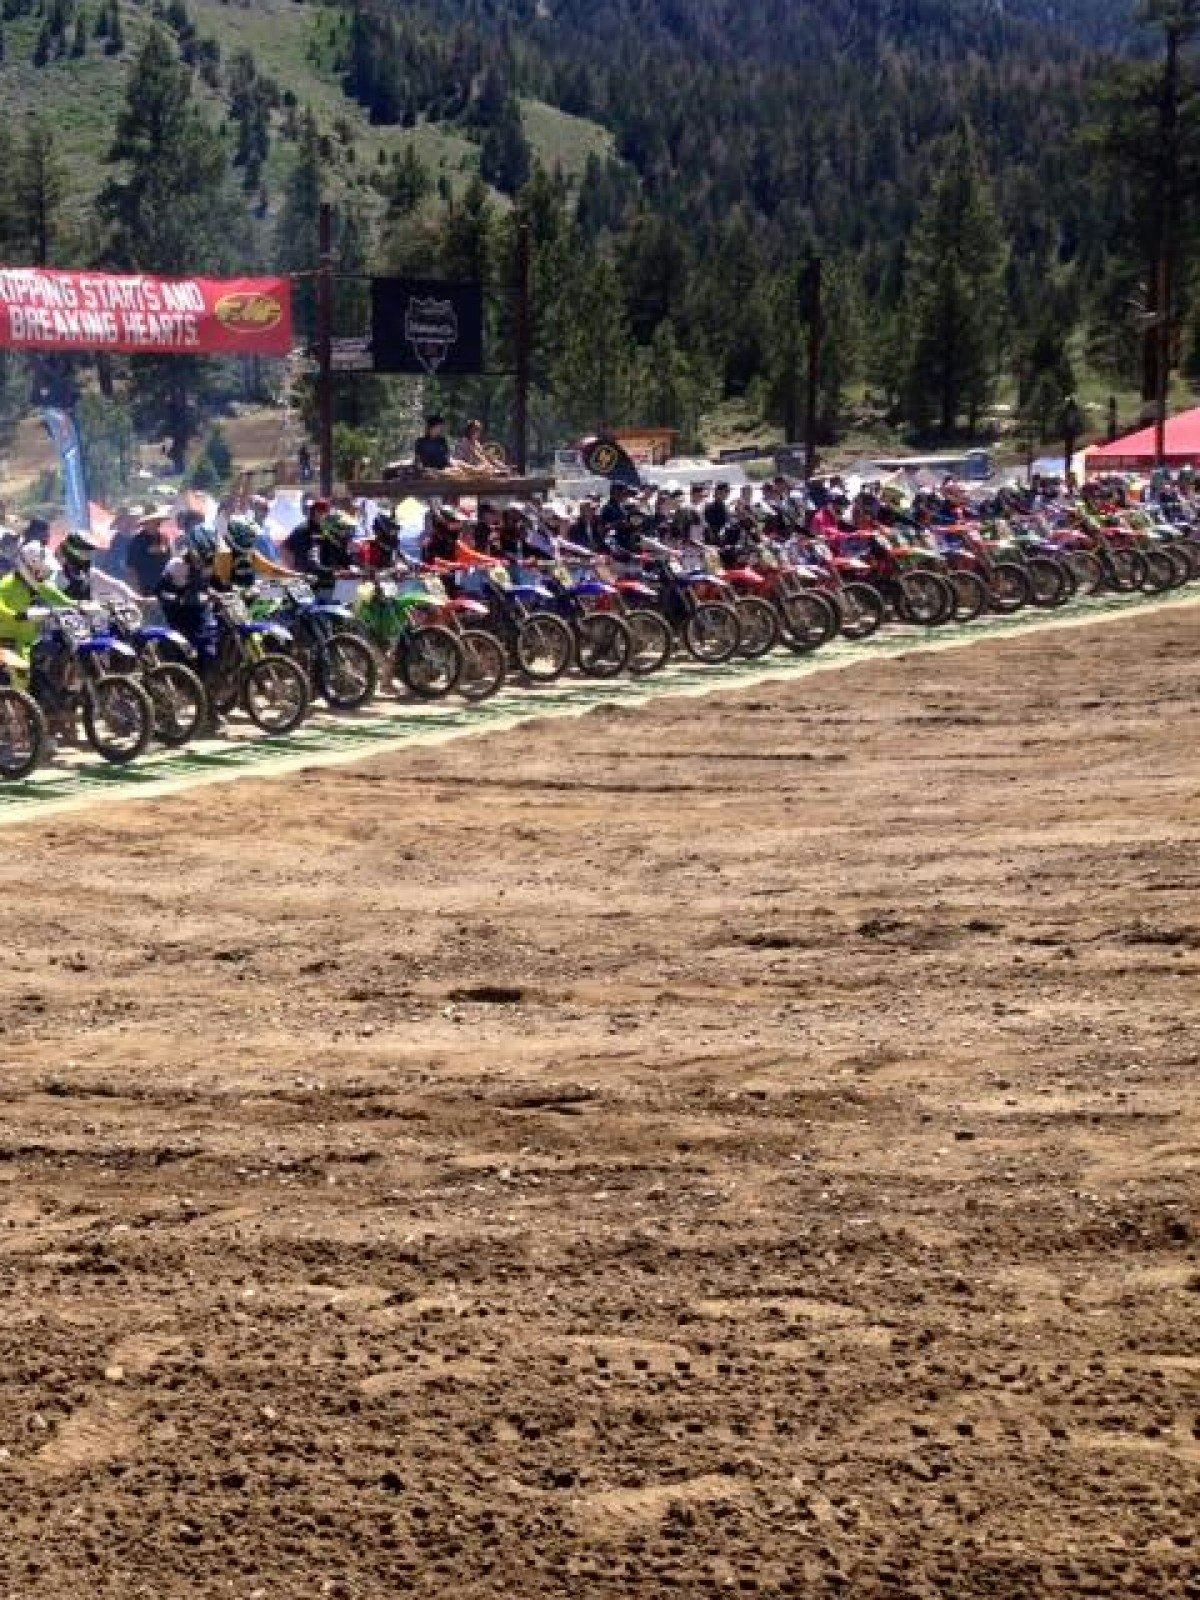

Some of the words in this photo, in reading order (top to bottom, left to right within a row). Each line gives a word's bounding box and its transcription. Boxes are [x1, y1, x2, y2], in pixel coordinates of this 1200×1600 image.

[79, 276, 161, 312] STARTS
[160, 280, 205, 312] AND
[9, 304, 119, 344] BREAKING
